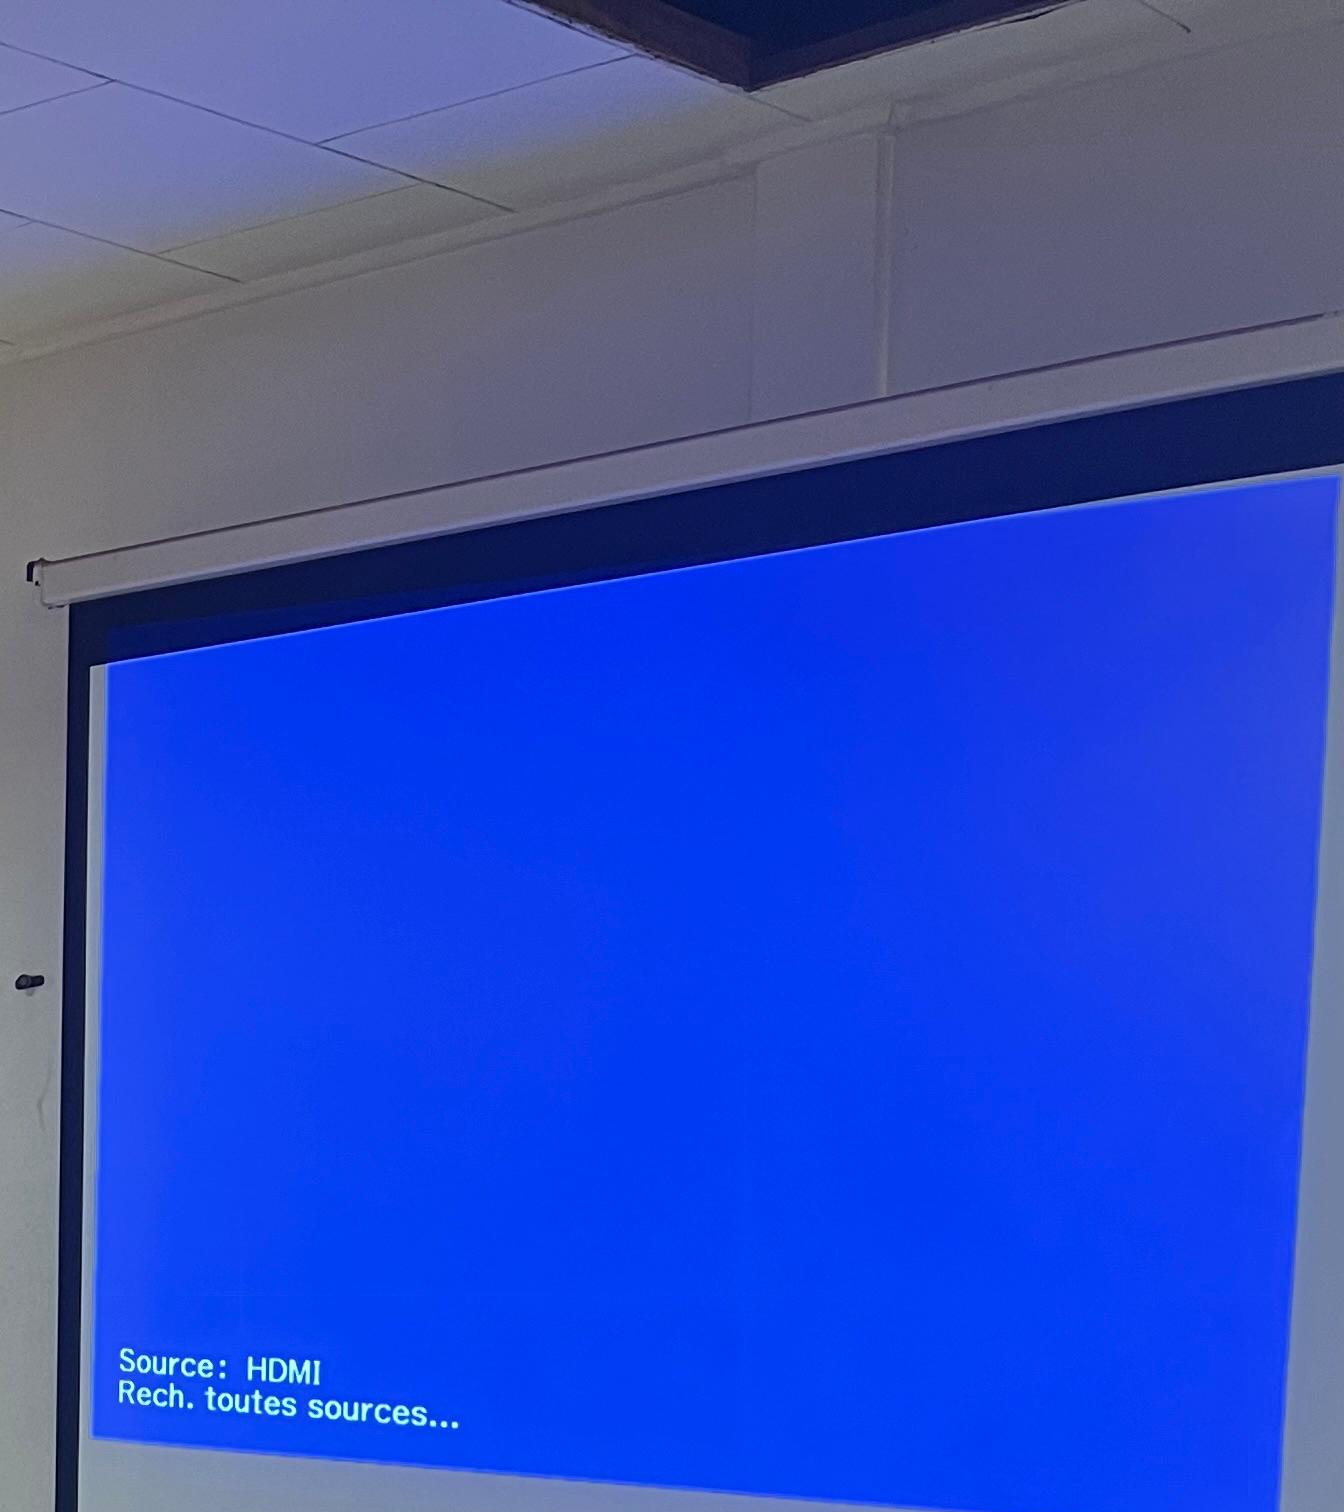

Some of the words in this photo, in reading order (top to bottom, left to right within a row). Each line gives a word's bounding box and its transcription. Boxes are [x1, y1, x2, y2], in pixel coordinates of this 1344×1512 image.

[119, 1348, 226, 1379] Source:
[247, 1356, 321, 1386] HDMI
[118, 1380, 193, 1409] Rech.
[205, 1386, 297, 1417] toutes
[308, 1398, 460, 1430] sources...
